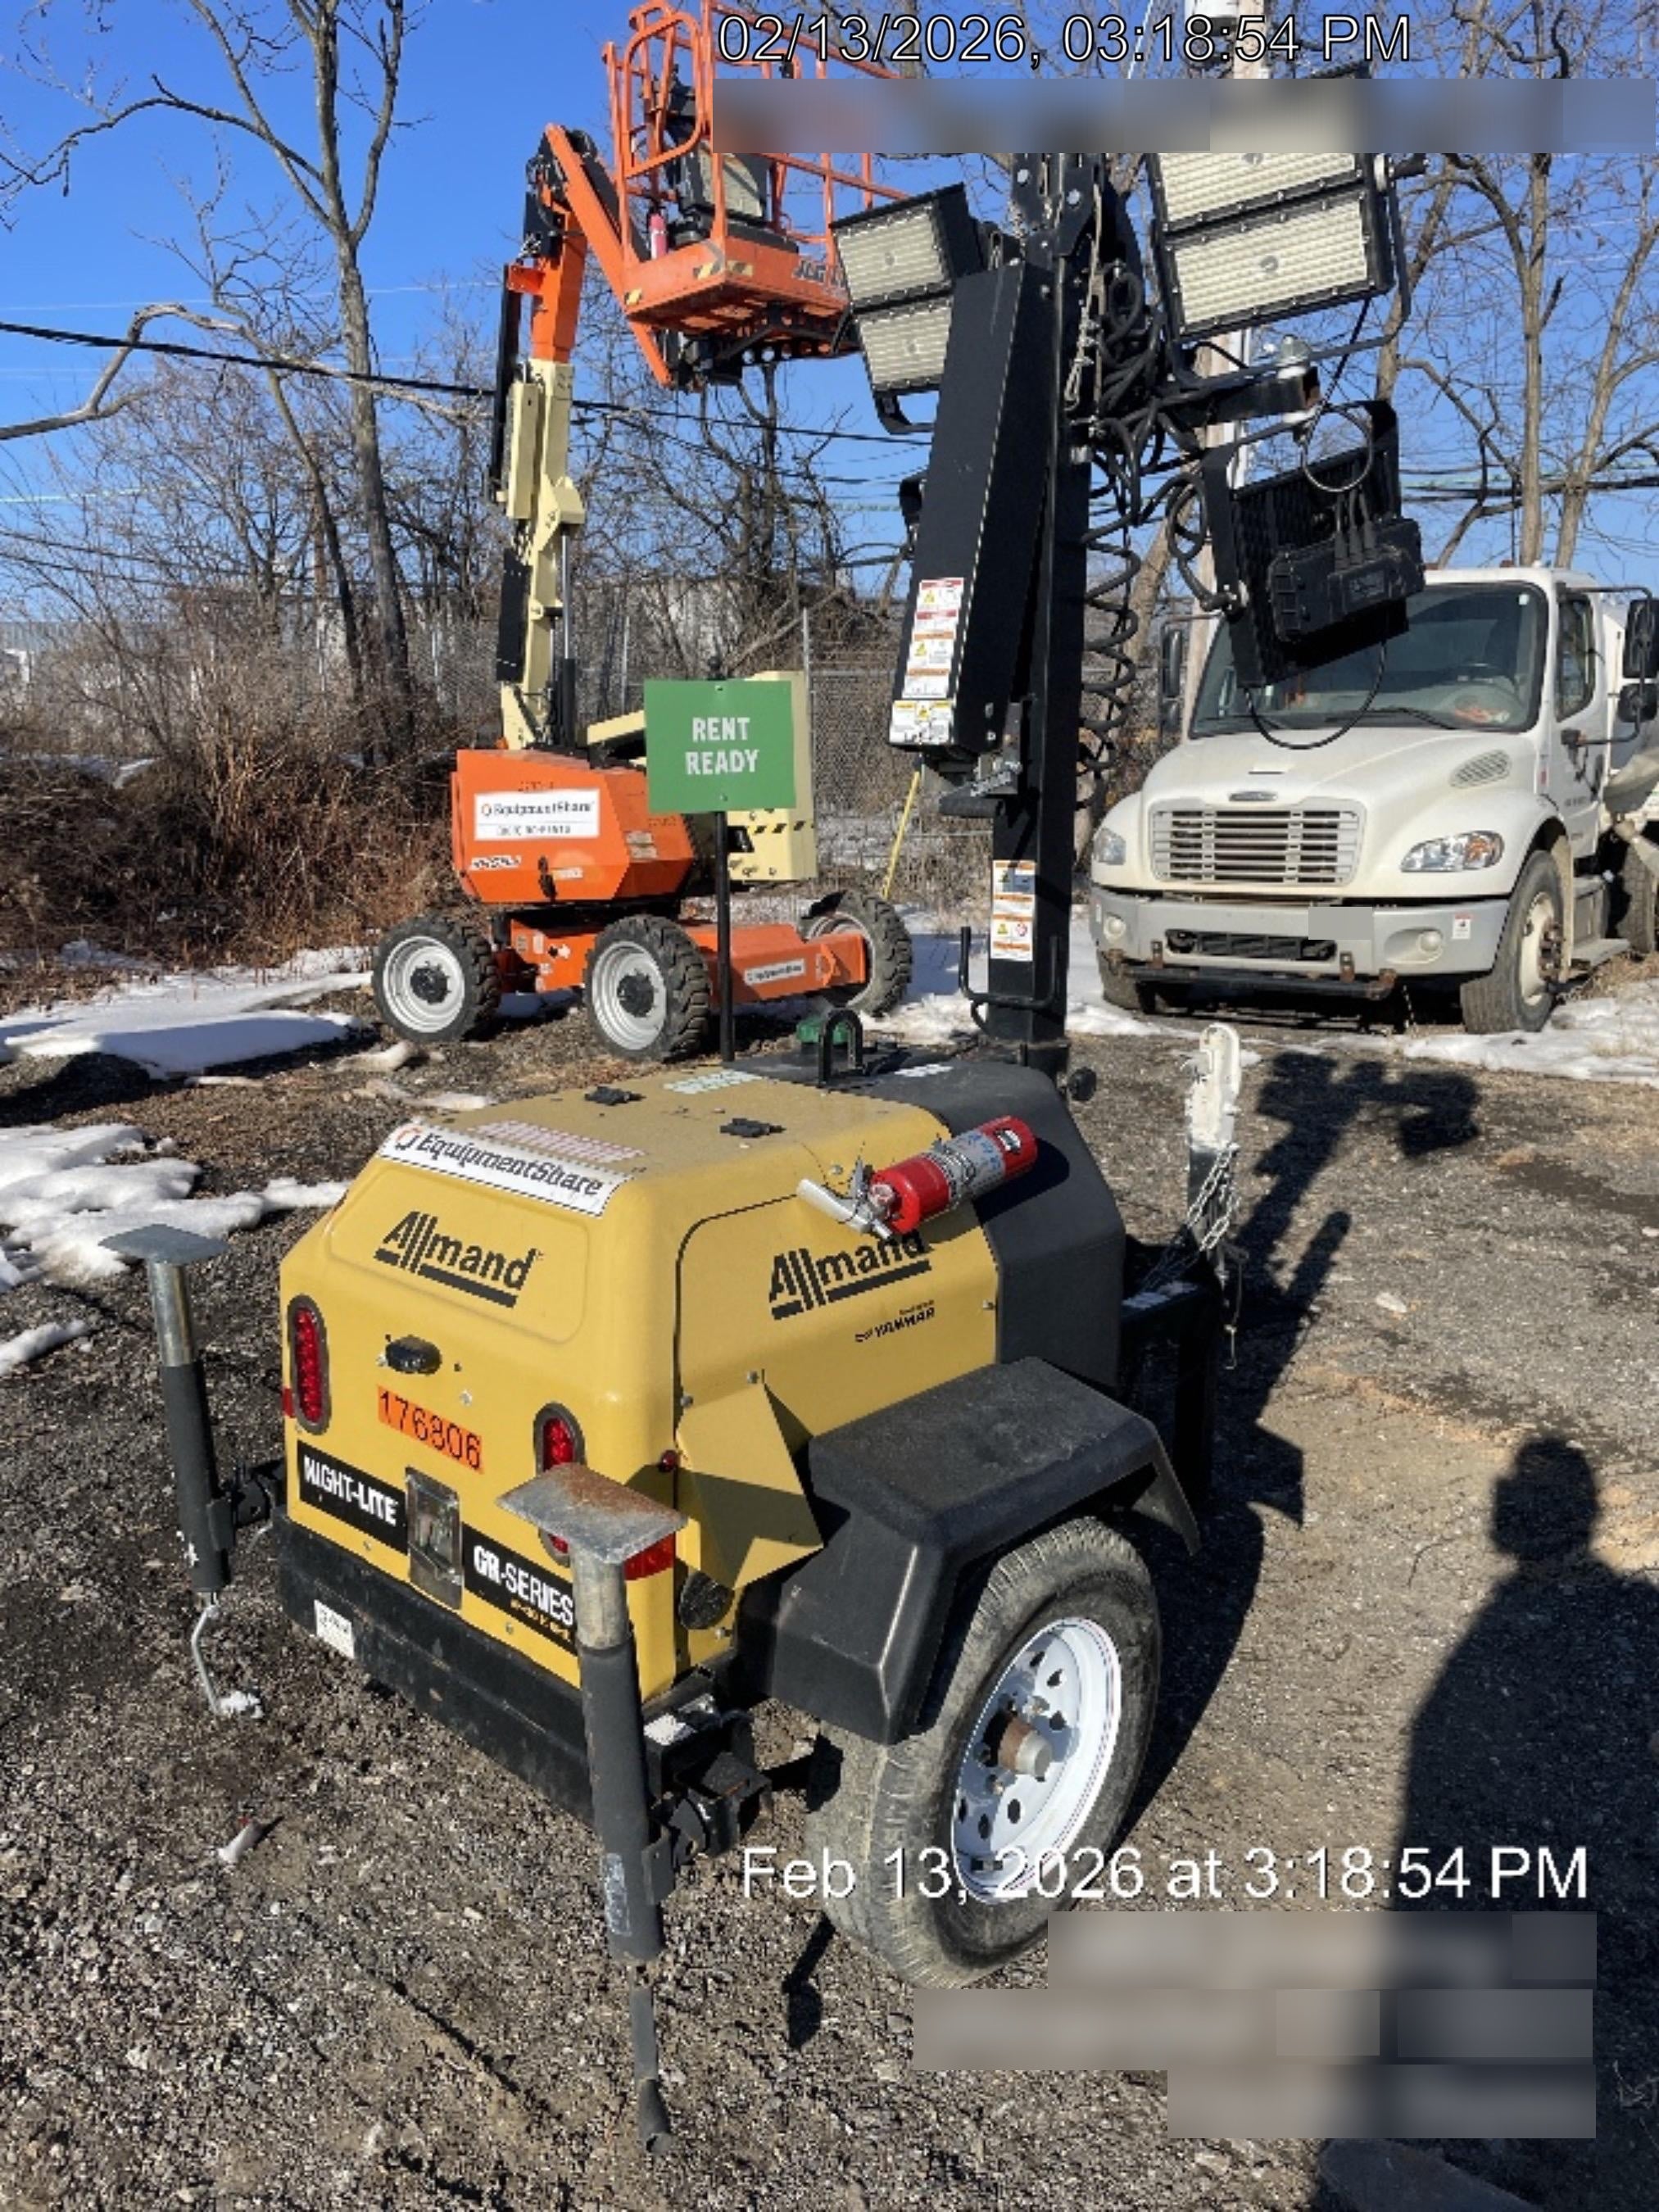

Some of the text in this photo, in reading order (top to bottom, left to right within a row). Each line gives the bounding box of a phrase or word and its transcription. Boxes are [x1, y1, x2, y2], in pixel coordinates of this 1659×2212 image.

[685, 749, 759, 775] READY
[692, 717, 750, 742] RENT
[415, 1132, 603, 1196] EquipmentShare
[382, 1211, 538, 1291] Allmand
[304, 1454, 398, 1527] NIGHT-LITE
[473, 1545, 573, 1626] GR-SERIES
